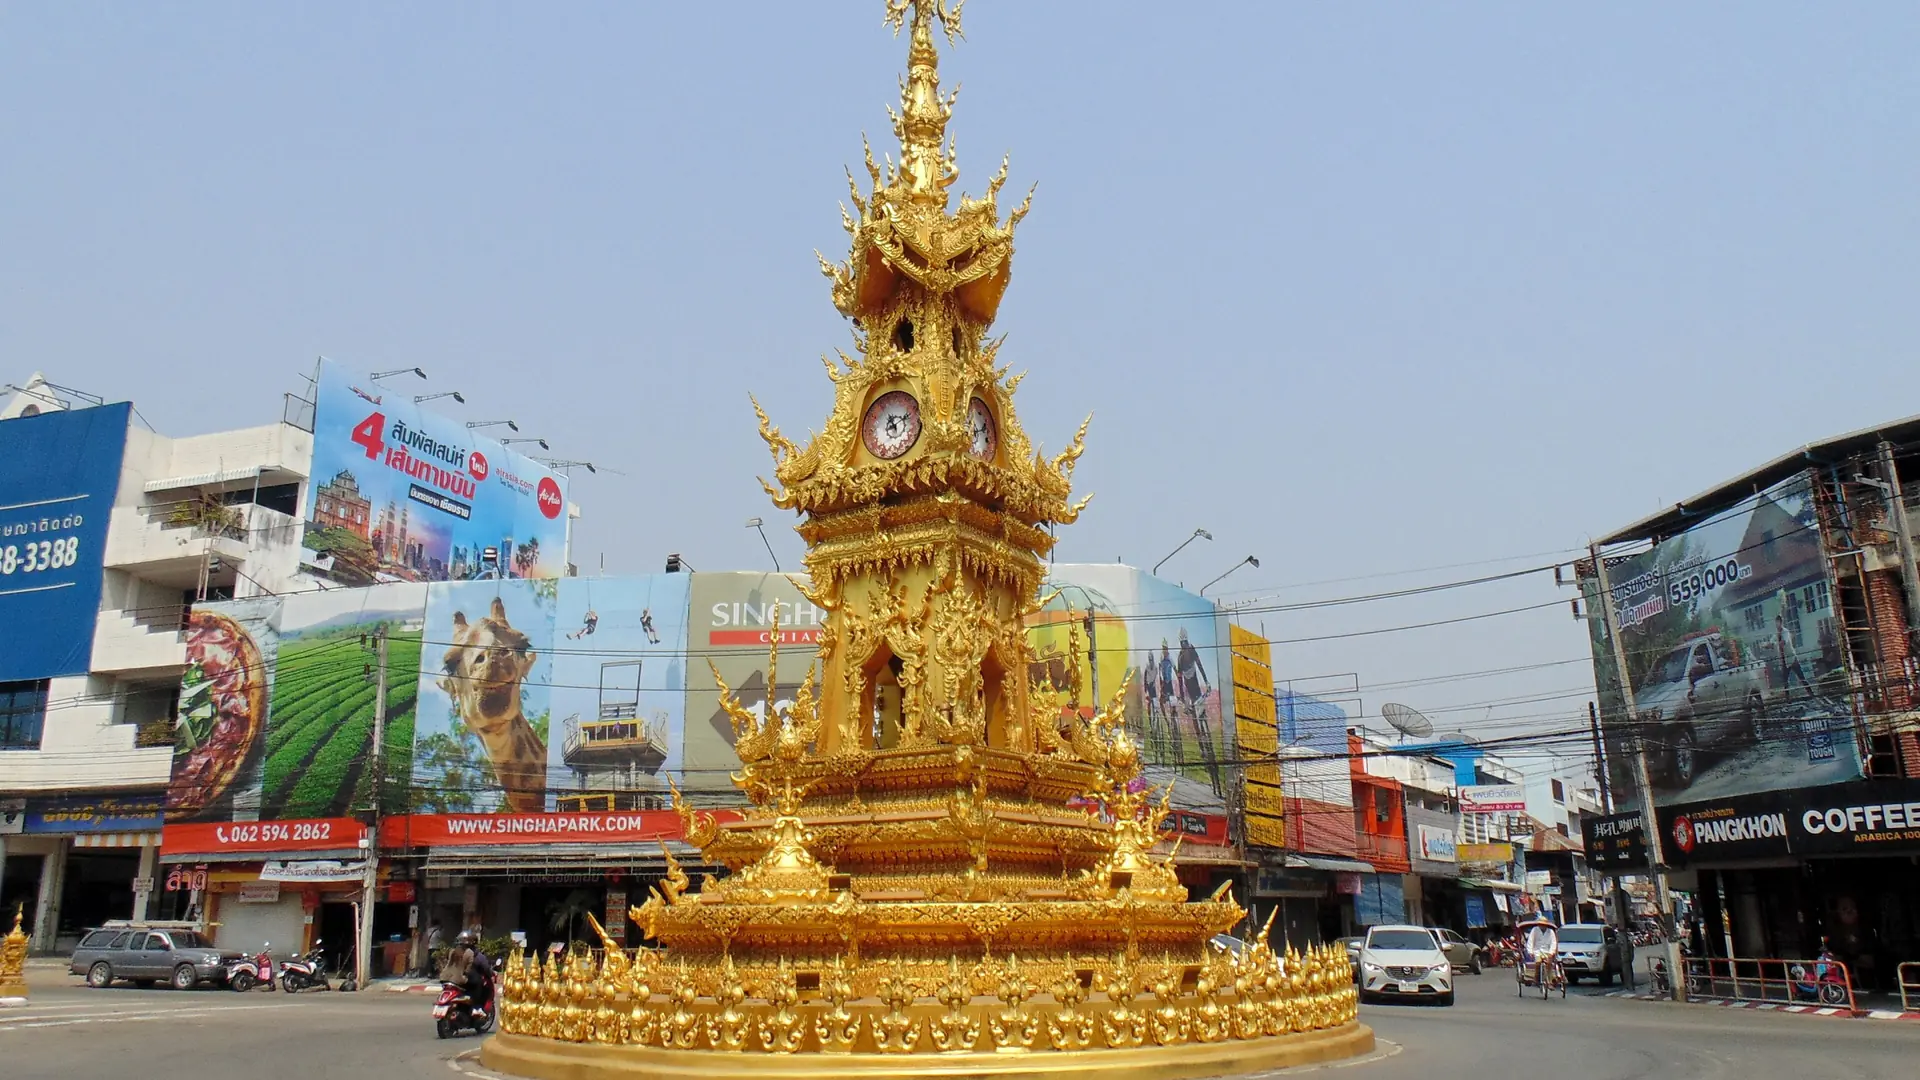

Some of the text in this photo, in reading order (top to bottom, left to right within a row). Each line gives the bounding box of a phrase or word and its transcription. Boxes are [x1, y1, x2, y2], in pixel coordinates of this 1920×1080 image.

[351, 412, 386, 460] 4
[385, 444, 476, 500] เส้นทางบิน
[496, 467, 535, 490] airasia.com
[0, 514, 83, 537] ษณาติดต่อ
[0, 536, 79, 575] 8-3388
[1670, 559, 1738, 605] 559,000
[1810, 746, 1833, 759] TOUGH
[447, 816, 642, 833] WWW.SINGHAPARK.COM
[1693, 813, 1786, 844] PANGKHON
[1802, 802, 1920, 834] COFFEE
[231, 822, 331, 842] 062 594 2862
[1855, 832, 1901, 842] ARABICA
